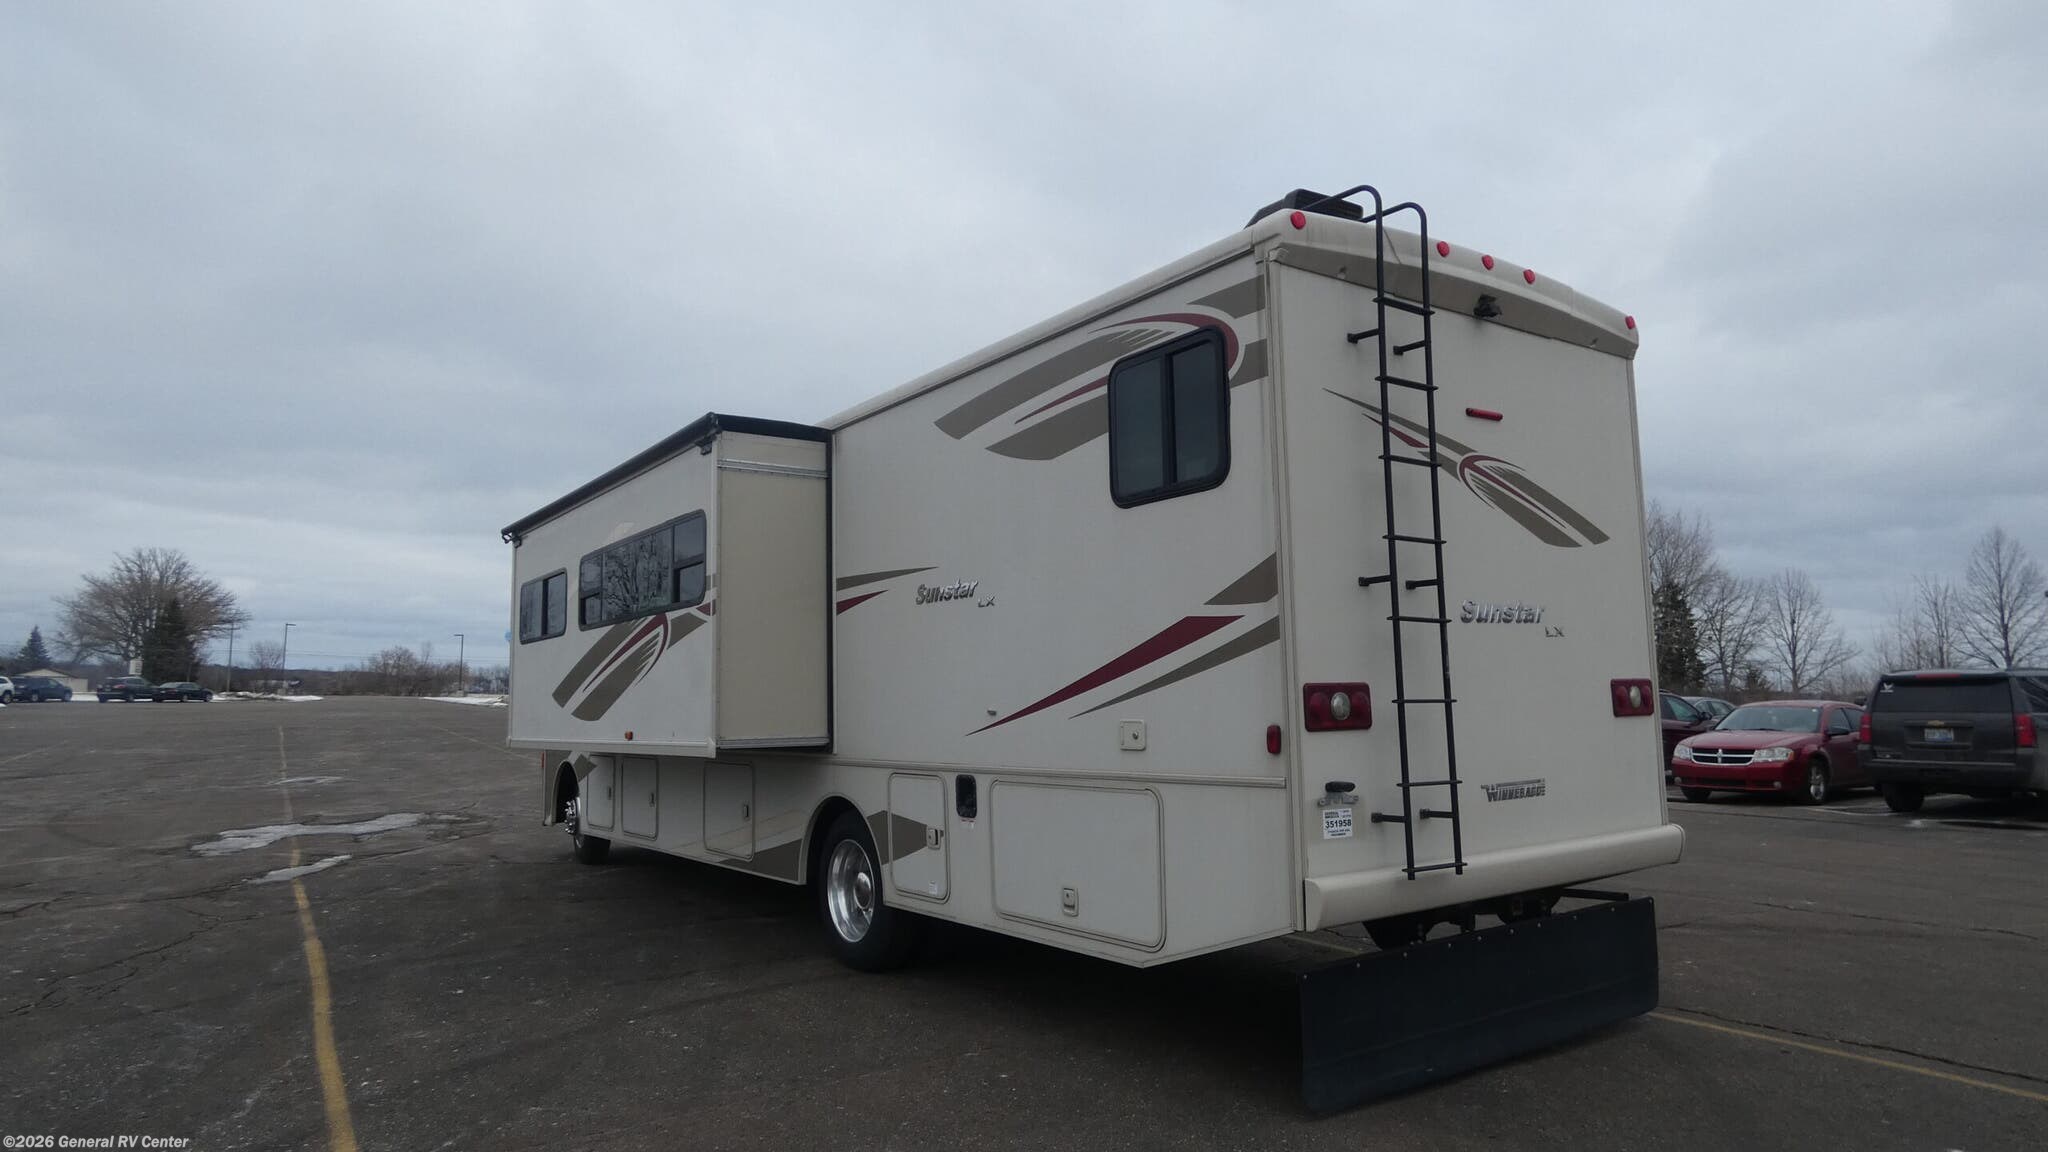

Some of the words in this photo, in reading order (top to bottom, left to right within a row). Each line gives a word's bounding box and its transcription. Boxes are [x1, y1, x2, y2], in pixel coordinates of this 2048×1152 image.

[916, 579, 979, 605] Sunstar
[978, 596, 995, 608] LX
[1461, 599, 1544, 624] Sunstar
[1545, 625, 1565, 638] LX
[1325, 819, 1352, 828] 351958
